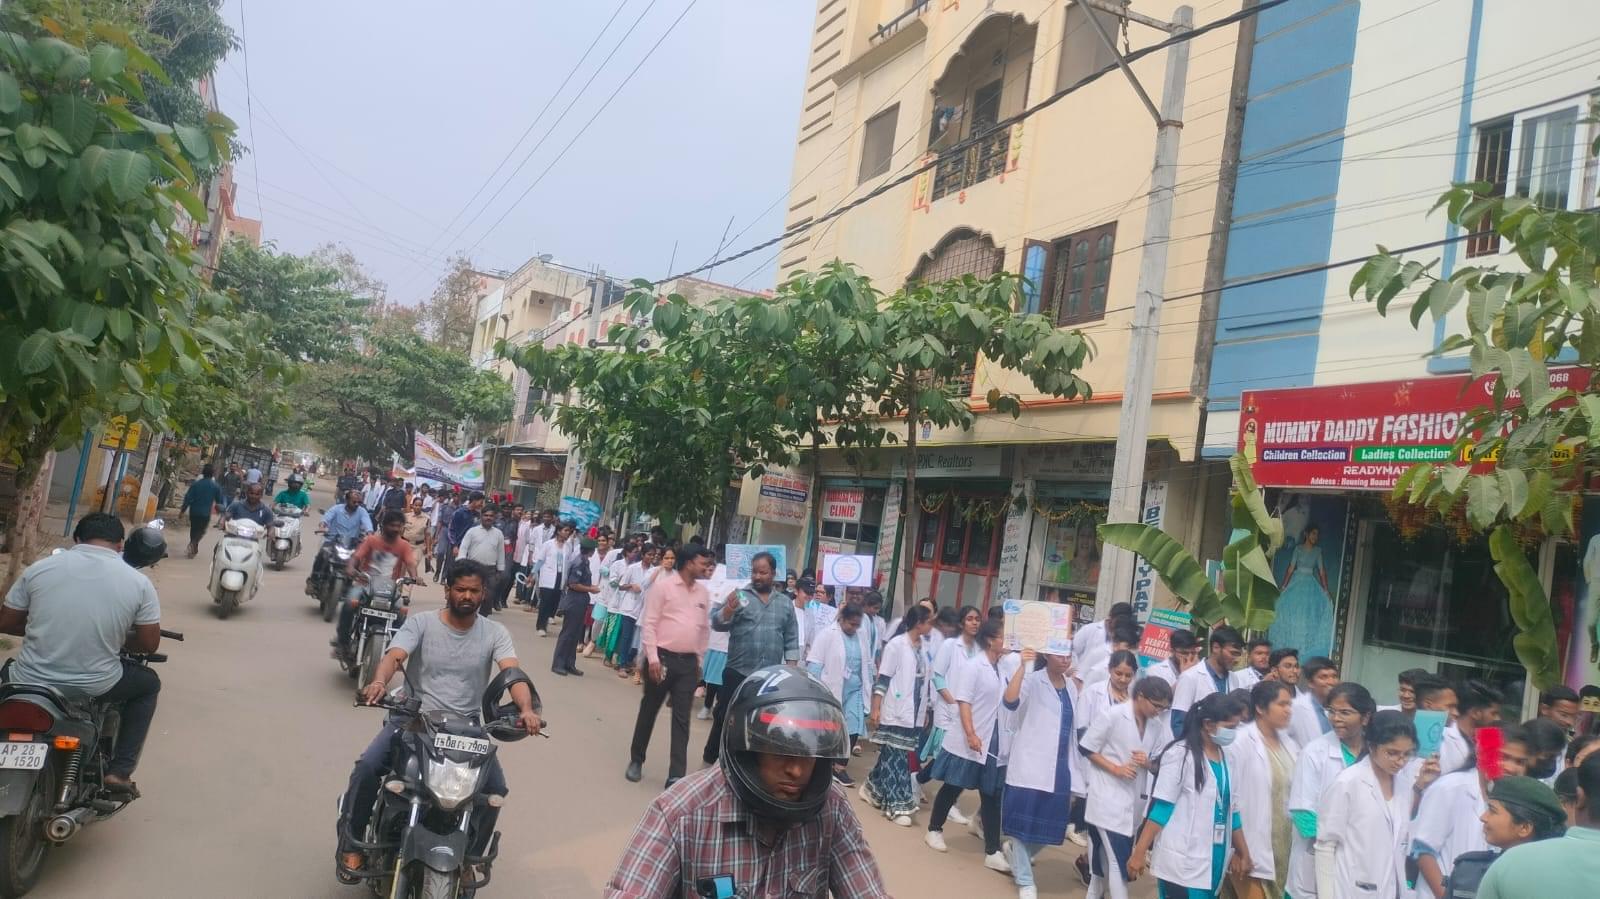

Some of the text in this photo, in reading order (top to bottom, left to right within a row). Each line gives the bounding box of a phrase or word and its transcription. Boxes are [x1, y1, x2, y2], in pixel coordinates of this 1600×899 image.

[1263, 420, 1320, 443] MUMMY
[1323, 418, 1377, 442] DADDY
[1263, 449, 1345, 460] Children Collection
[1361, 446, 1450, 460] Ladies Collection
[1310, 478, 1335, 486] Address
[1341, 478, 1368, 487] Housing
[1369, 478, 1390, 487] Board
[830, 504, 856, 518] CLINIC
[1, 744, 36, 755] AP 28
[467, 742, 488, 753] 7909
[14, 756, 40, 767] 1520
